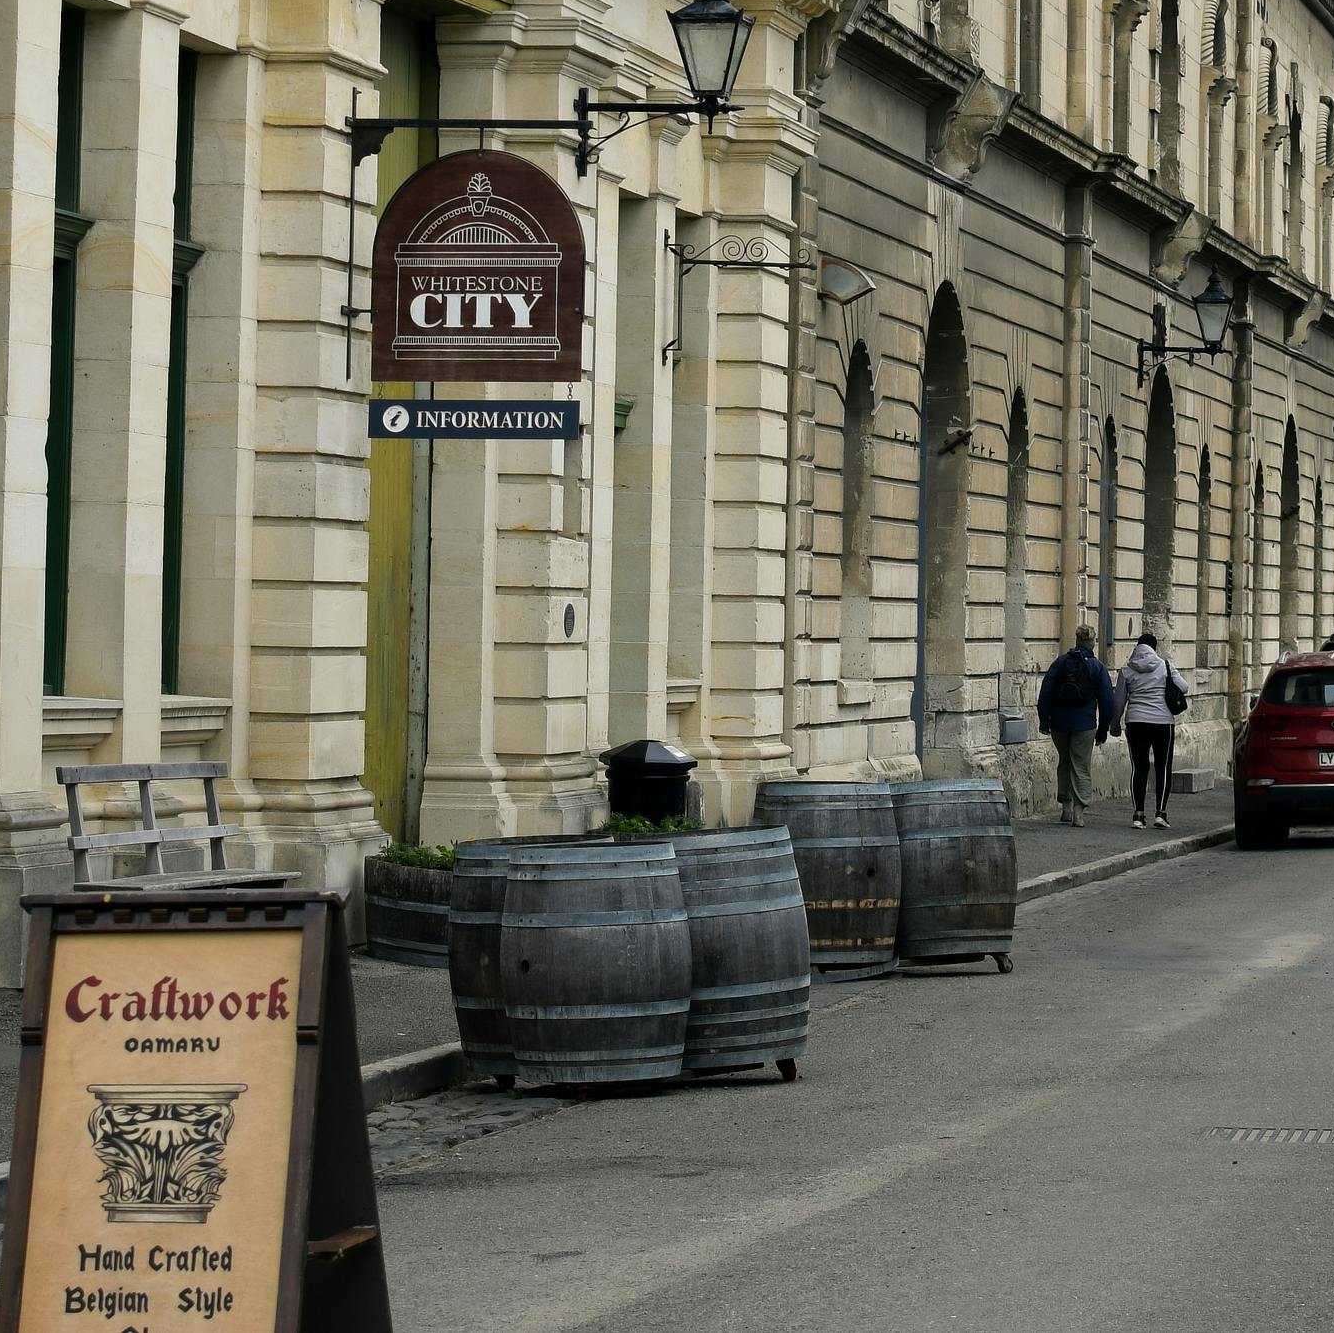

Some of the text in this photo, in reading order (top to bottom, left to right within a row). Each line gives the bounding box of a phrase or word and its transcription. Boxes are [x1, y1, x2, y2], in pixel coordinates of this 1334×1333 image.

[411, 276, 544, 291] WHITESTONE
[409, 292, 544, 329] CITY
[416, 410, 566, 429] INFORMATION
[65, 975, 290, 1023] Craftwork
[124, 1037, 220, 1053] OAMARU
[77, 1244, 233, 1272] Hand Crafted
[64, 1286, 234, 1319] Belgian Style
